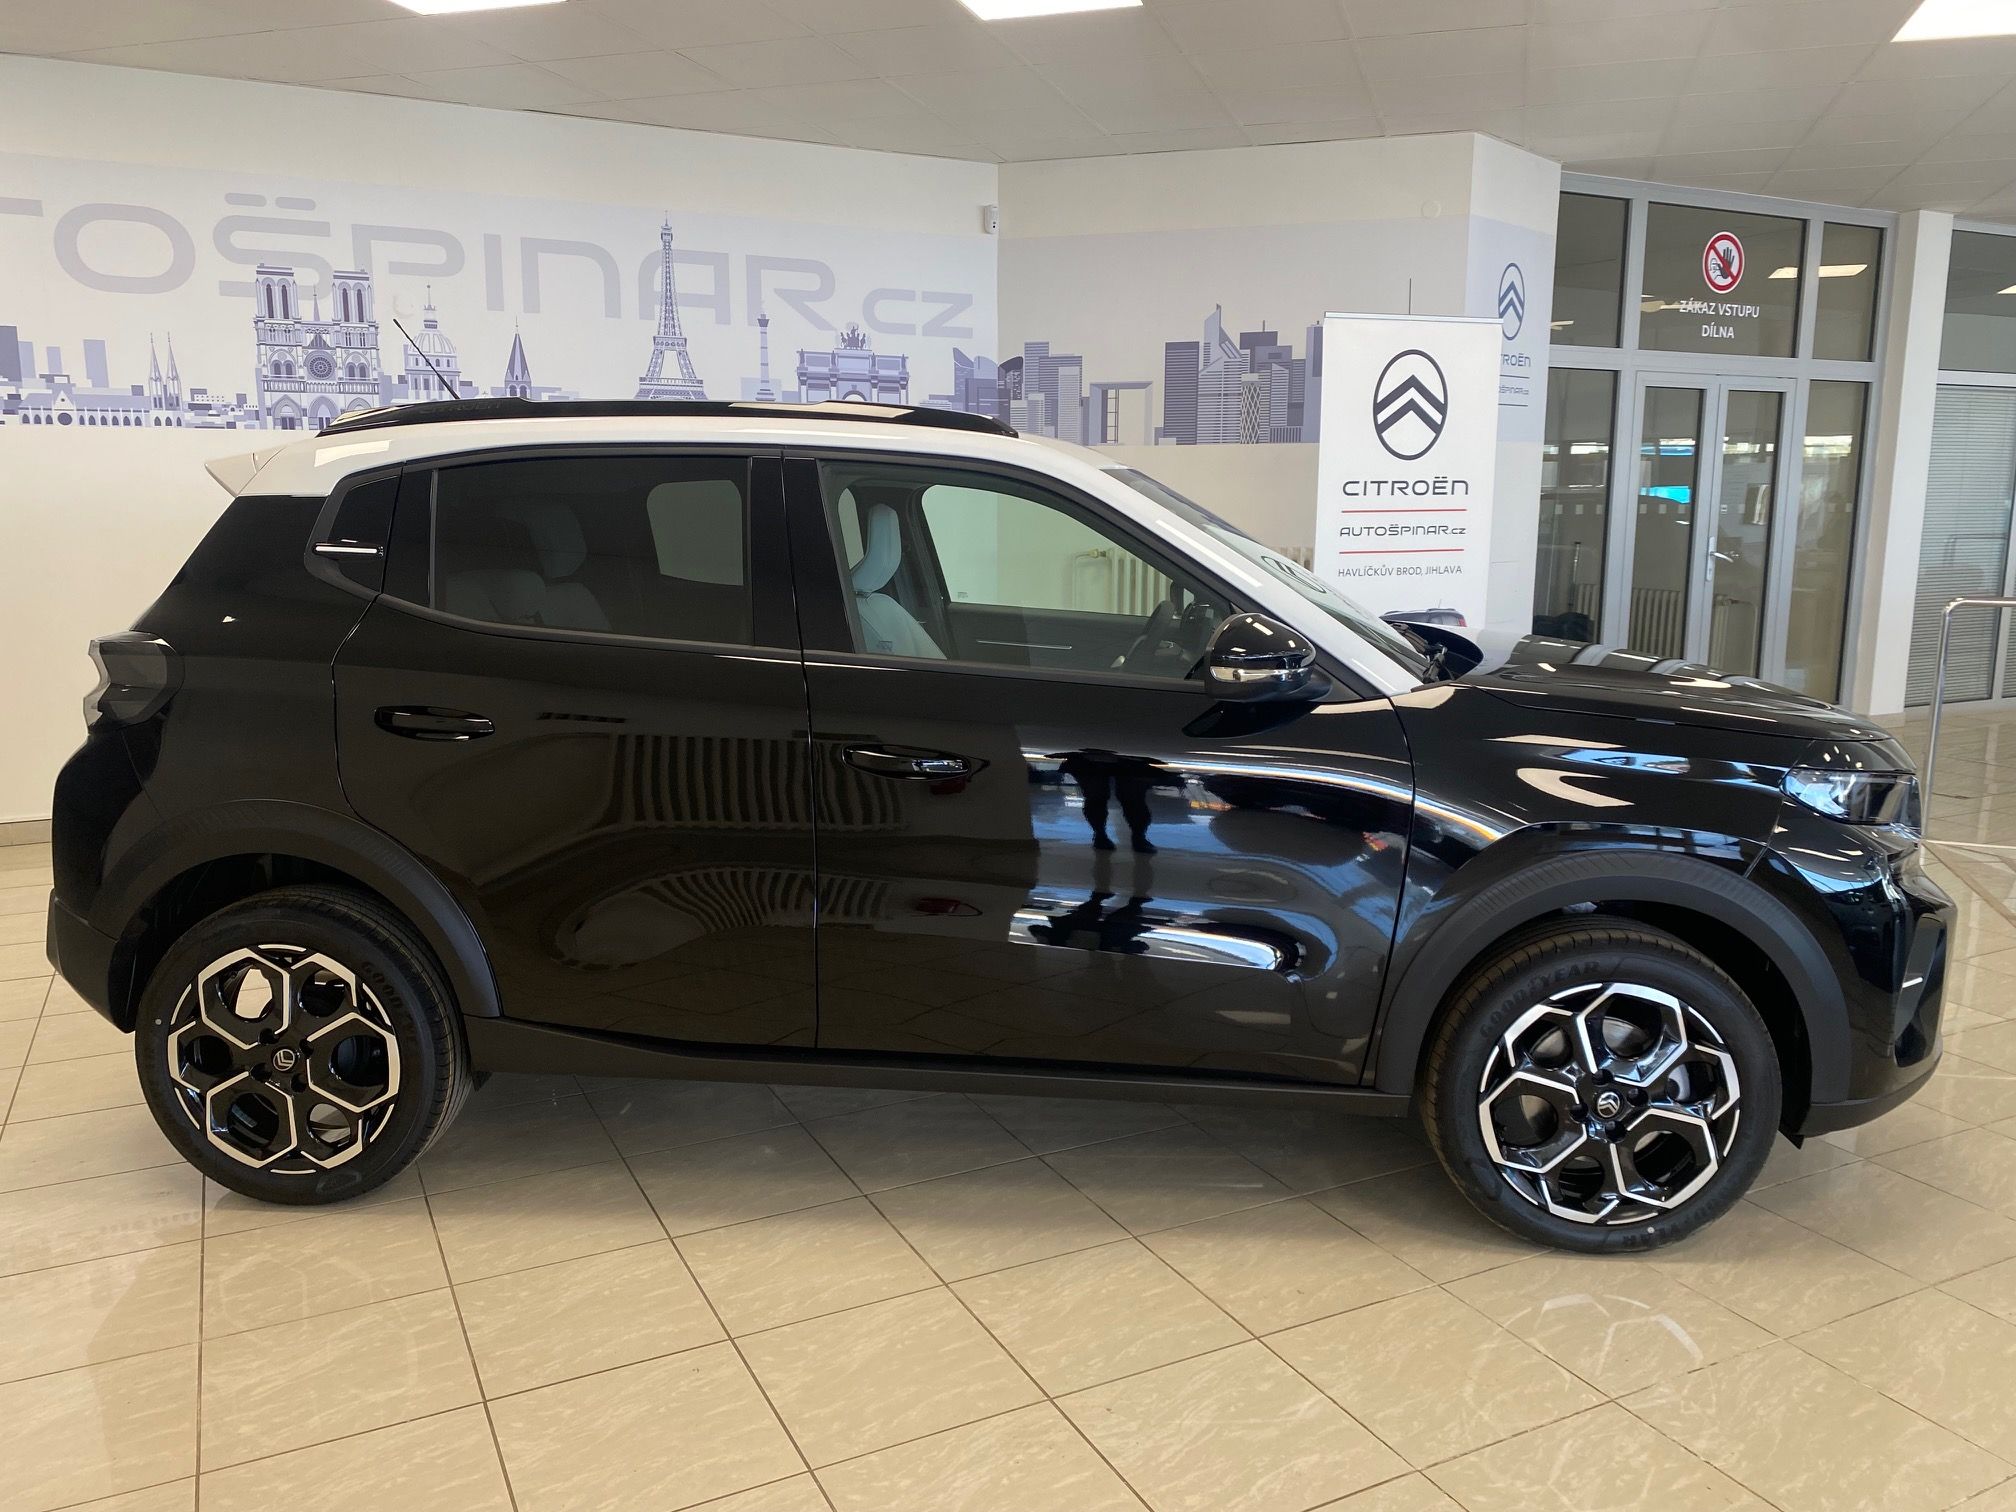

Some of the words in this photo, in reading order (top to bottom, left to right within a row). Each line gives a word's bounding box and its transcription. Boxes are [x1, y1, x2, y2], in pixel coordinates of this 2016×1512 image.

[1679, 298, 1716, 315] ZÁKAZ
[1718, 303, 1760, 318] VSTUPU
[1701, 322, 1735, 338] DÍLNA
[1501, 352, 1531, 367] ROËN
[1342, 476, 1469, 496] CITROËN
[1339, 524, 1467, 536] AUTOŠPINAR.cz
[1338, 564, 1394, 577] HAVLÍČKŮV
[1396, 566, 1423, 577] BROD,
[1425, 565, 1462, 575] JIHLAVA
